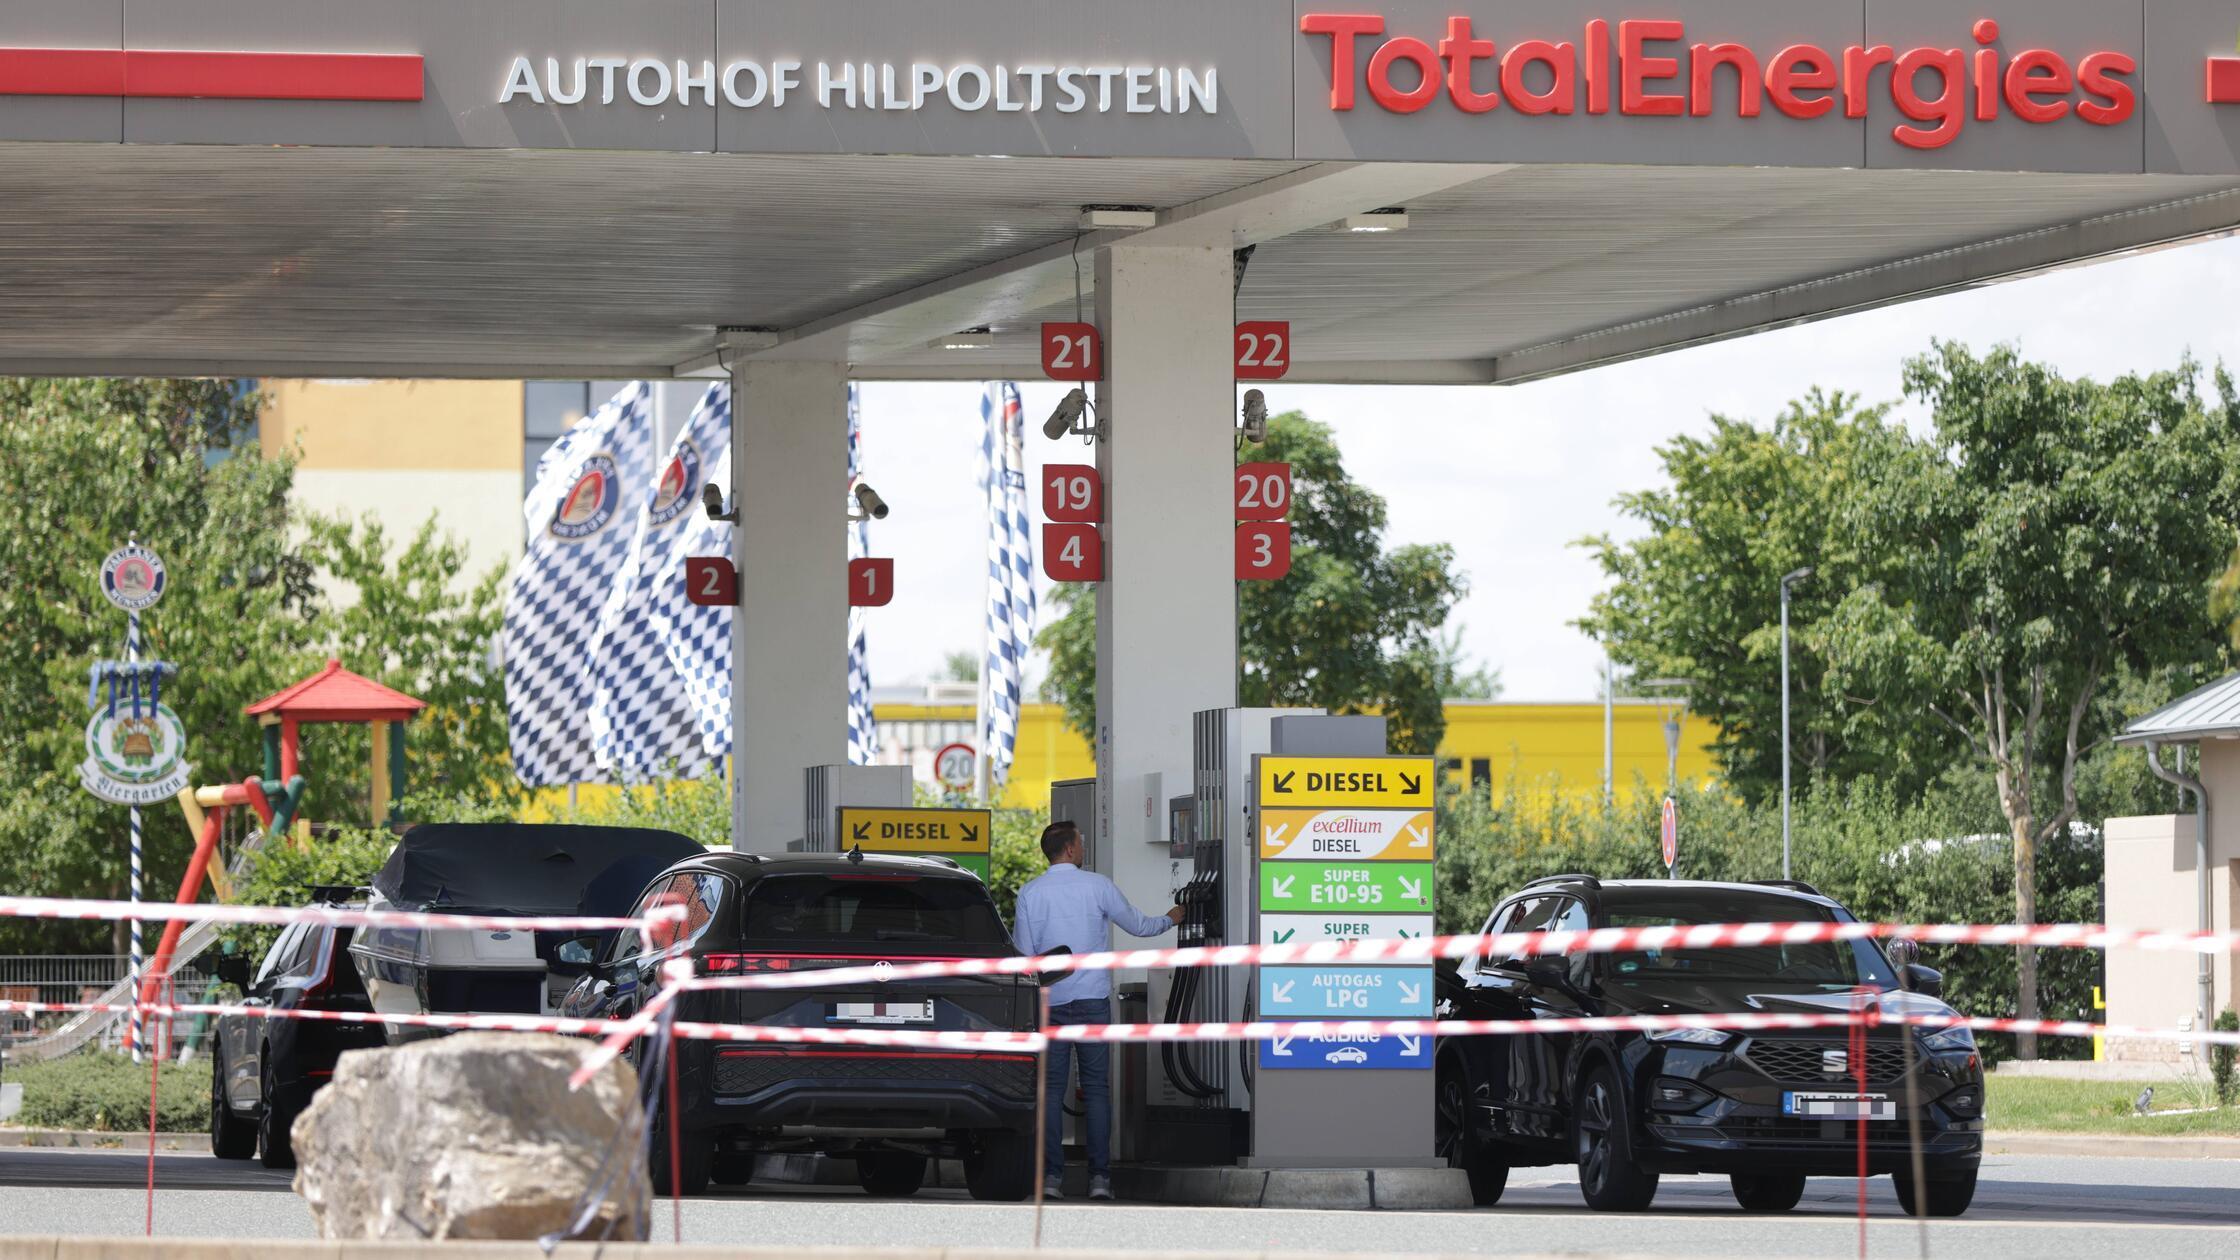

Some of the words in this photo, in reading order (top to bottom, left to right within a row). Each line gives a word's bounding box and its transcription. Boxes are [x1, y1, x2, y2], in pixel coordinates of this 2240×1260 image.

[499, 56, 802, 108] AUTOHOF
[818, 61, 1218, 114] HILPOLTSTEIN
[1300, 13, 2136, 150] TotalEnergies
[1051, 335, 1091, 369] 21
[1238, 333, 1284, 367] 22
[1050, 476, 1092, 510] 19
[1238, 474, 1285, 508] 20
[1059, 535, 1084, 568] 4
[1252, 533, 1273, 567] 3
[701, 567, 720, 595] 2
[862, 568, 876, 596] 1
[943, 754, 973, 779] 20
[97, 776, 181, 803] Biergarten
[1307, 773, 1388, 792] DIESEL
[881, 823, 950, 839] DIESEL
[1313, 817, 1382, 833] excellium
[1313, 839, 1360, 852] DIESEL
[1324, 870, 1369, 882] SUPER
[1311, 884, 1383, 904] E10-95
[1324, 923, 1370, 935] SUPER
[1312, 974, 1382, 987] AUTOGAS
[1326, 989, 1368, 1008] LPG
